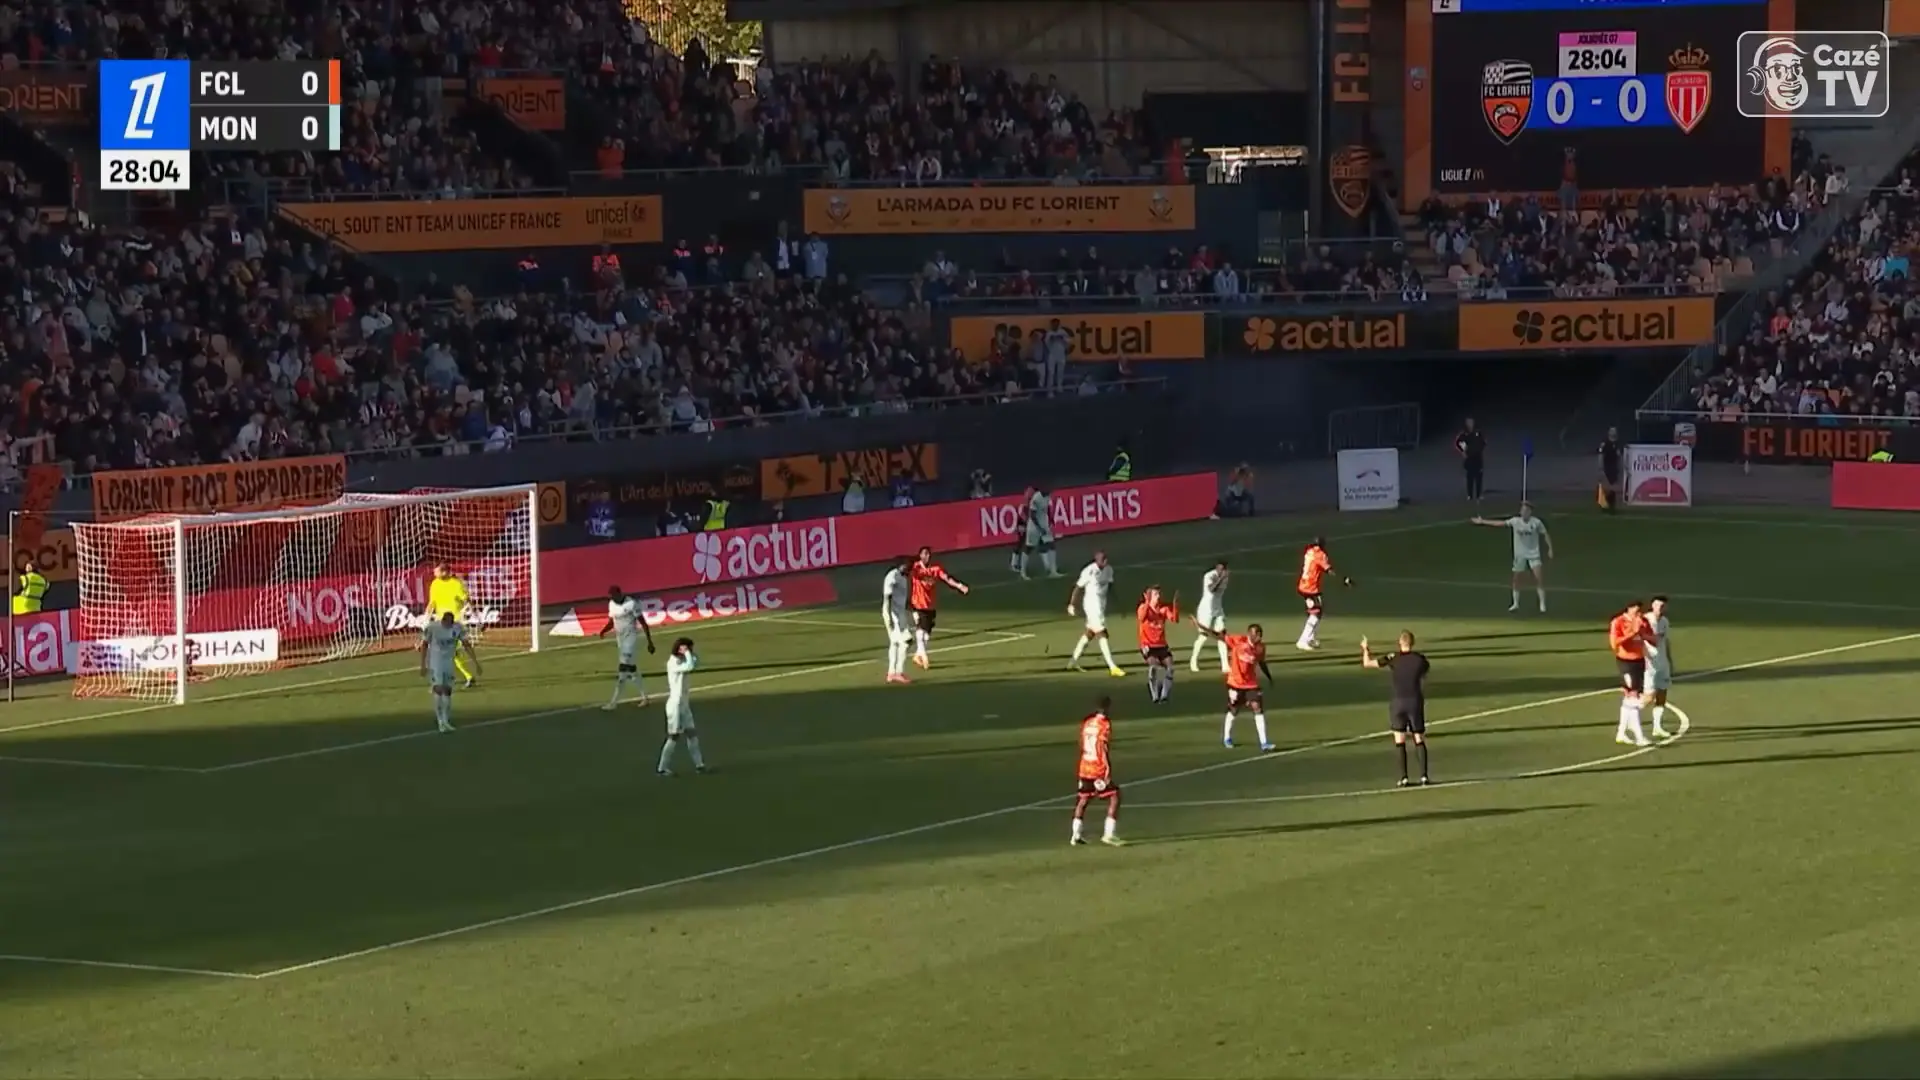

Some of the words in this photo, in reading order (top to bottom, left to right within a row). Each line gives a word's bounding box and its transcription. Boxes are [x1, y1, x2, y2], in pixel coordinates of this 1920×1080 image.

[1568, 48, 1627, 70] 28:04
[1546, 81, 1574, 124] 0
[1619, 79, 1647, 122] 0
[416, 213, 454, 233] TEAM
[457, 212, 506, 231] UNICEF
[510, 211, 562, 230] FRANCE
[585, 203, 629, 225] unicef
[877, 198, 974, 213] L'ARMADA
[980, 197, 1007, 211] DU
[1013, 197, 1036, 210] FC
[1041, 196, 1120, 210] LORIENT
[1281, 313, 1405, 350] actual
[1551, 306, 1675, 342] actual
[1744, 428, 1774, 456] FC
[1784, 429, 1892, 458] LORIENT
[97, 478, 176, 516] LORIENT
[182, 473, 227, 511] FOOT
[234, 461, 344, 506] SUPPORTERS
[727, 516, 838, 577] actual
[640, 583, 783, 625] Betclic
